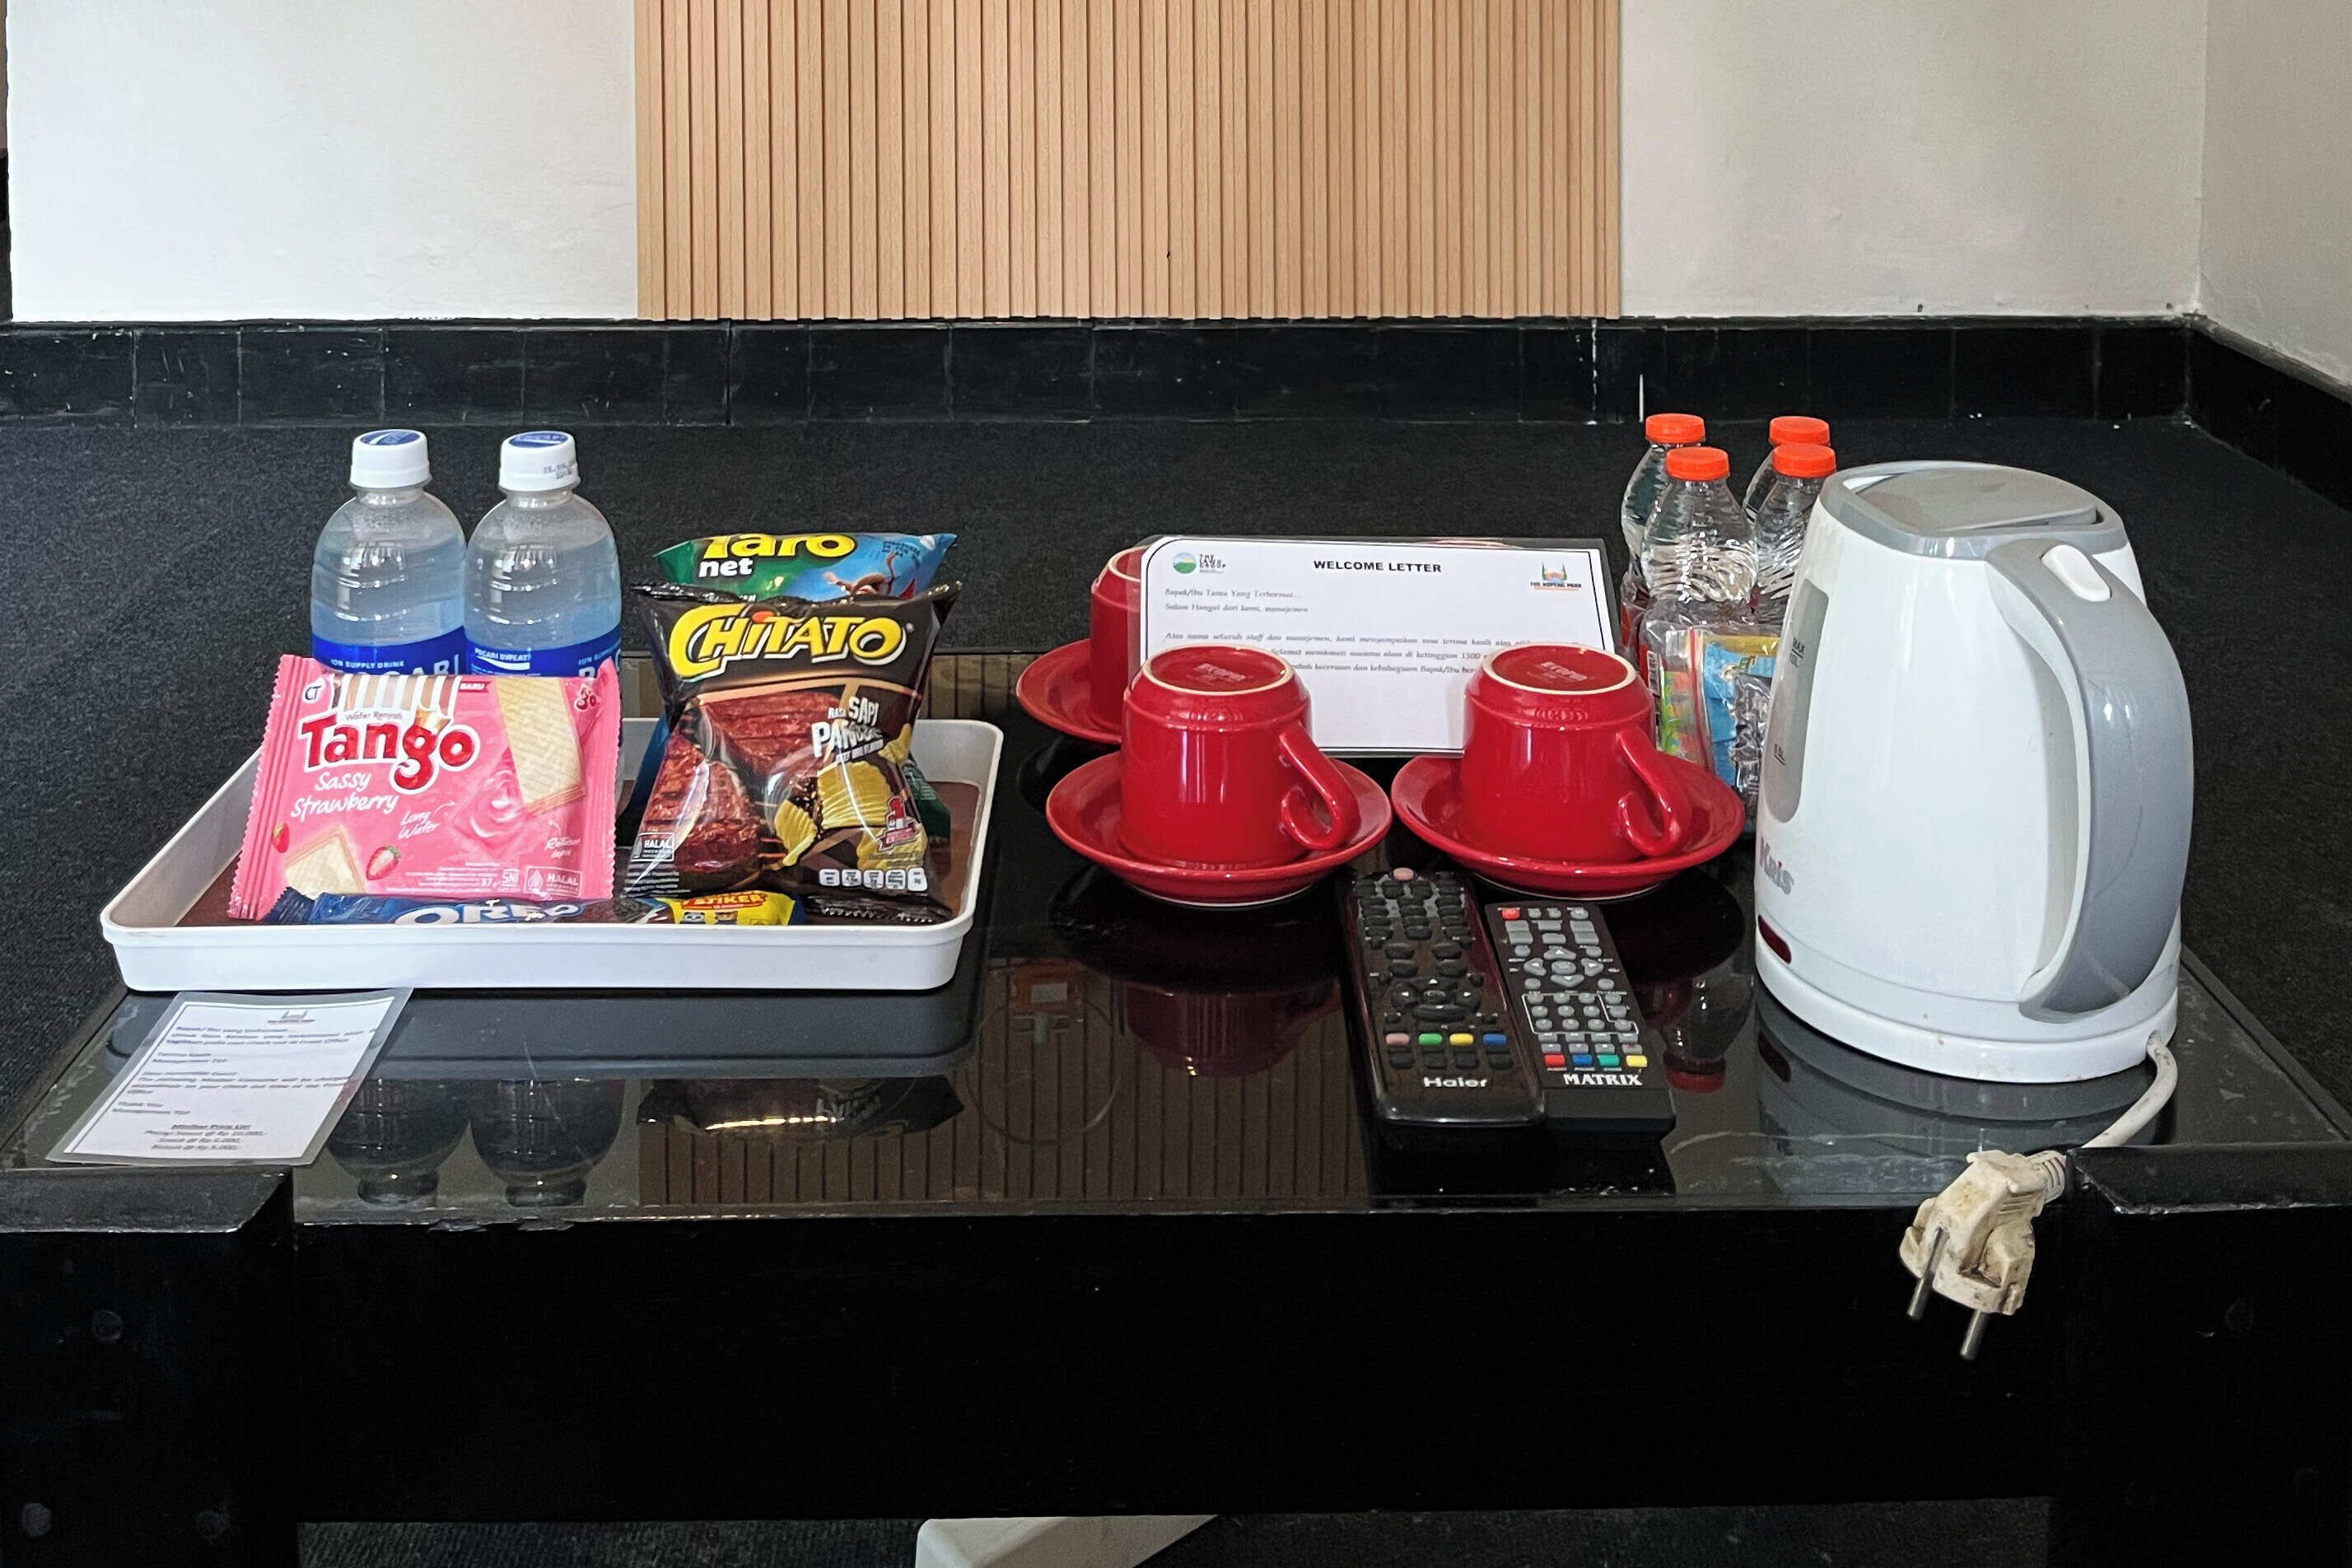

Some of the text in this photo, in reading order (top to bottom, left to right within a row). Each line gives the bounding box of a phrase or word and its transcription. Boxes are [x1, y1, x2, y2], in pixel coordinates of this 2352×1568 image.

[698, 558, 754, 577] net
[1313, 560, 1442, 572] WELCOME LETTER
[345, 660, 376, 669] SUPPLY
[848, 696, 880, 726] SAPI
[301, 714, 474, 791] Tango
[315, 771, 371, 791] Sassy
[291, 791, 399, 822] Strawberry
[547, 873, 579, 886] HALAL
[1423, 1076, 1487, 1087] Haier
[1563, 1073, 1643, 1086] MATRIX
